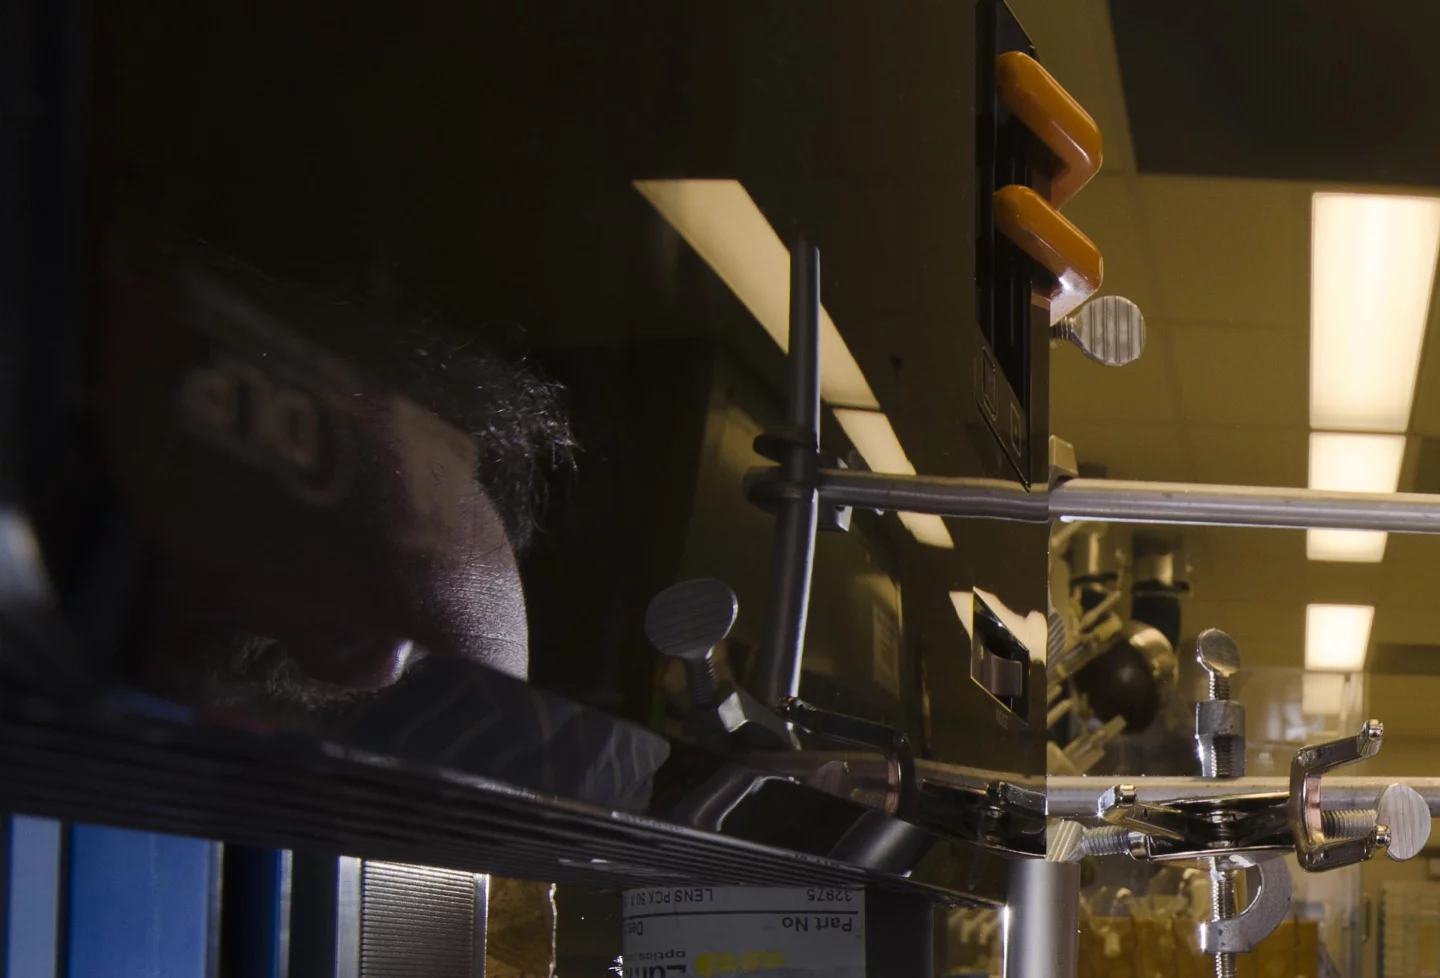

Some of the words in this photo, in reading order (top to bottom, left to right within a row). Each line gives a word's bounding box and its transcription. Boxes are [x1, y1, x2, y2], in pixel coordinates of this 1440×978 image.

[648, 890, 671, 904] PCX
[675, 888, 713, 903] LENS
[806, 889, 852, 902] 32975
[782, 917, 808, 932] No
[815, 917, 852, 932] Part
[639, 949, 686, 961] optics
